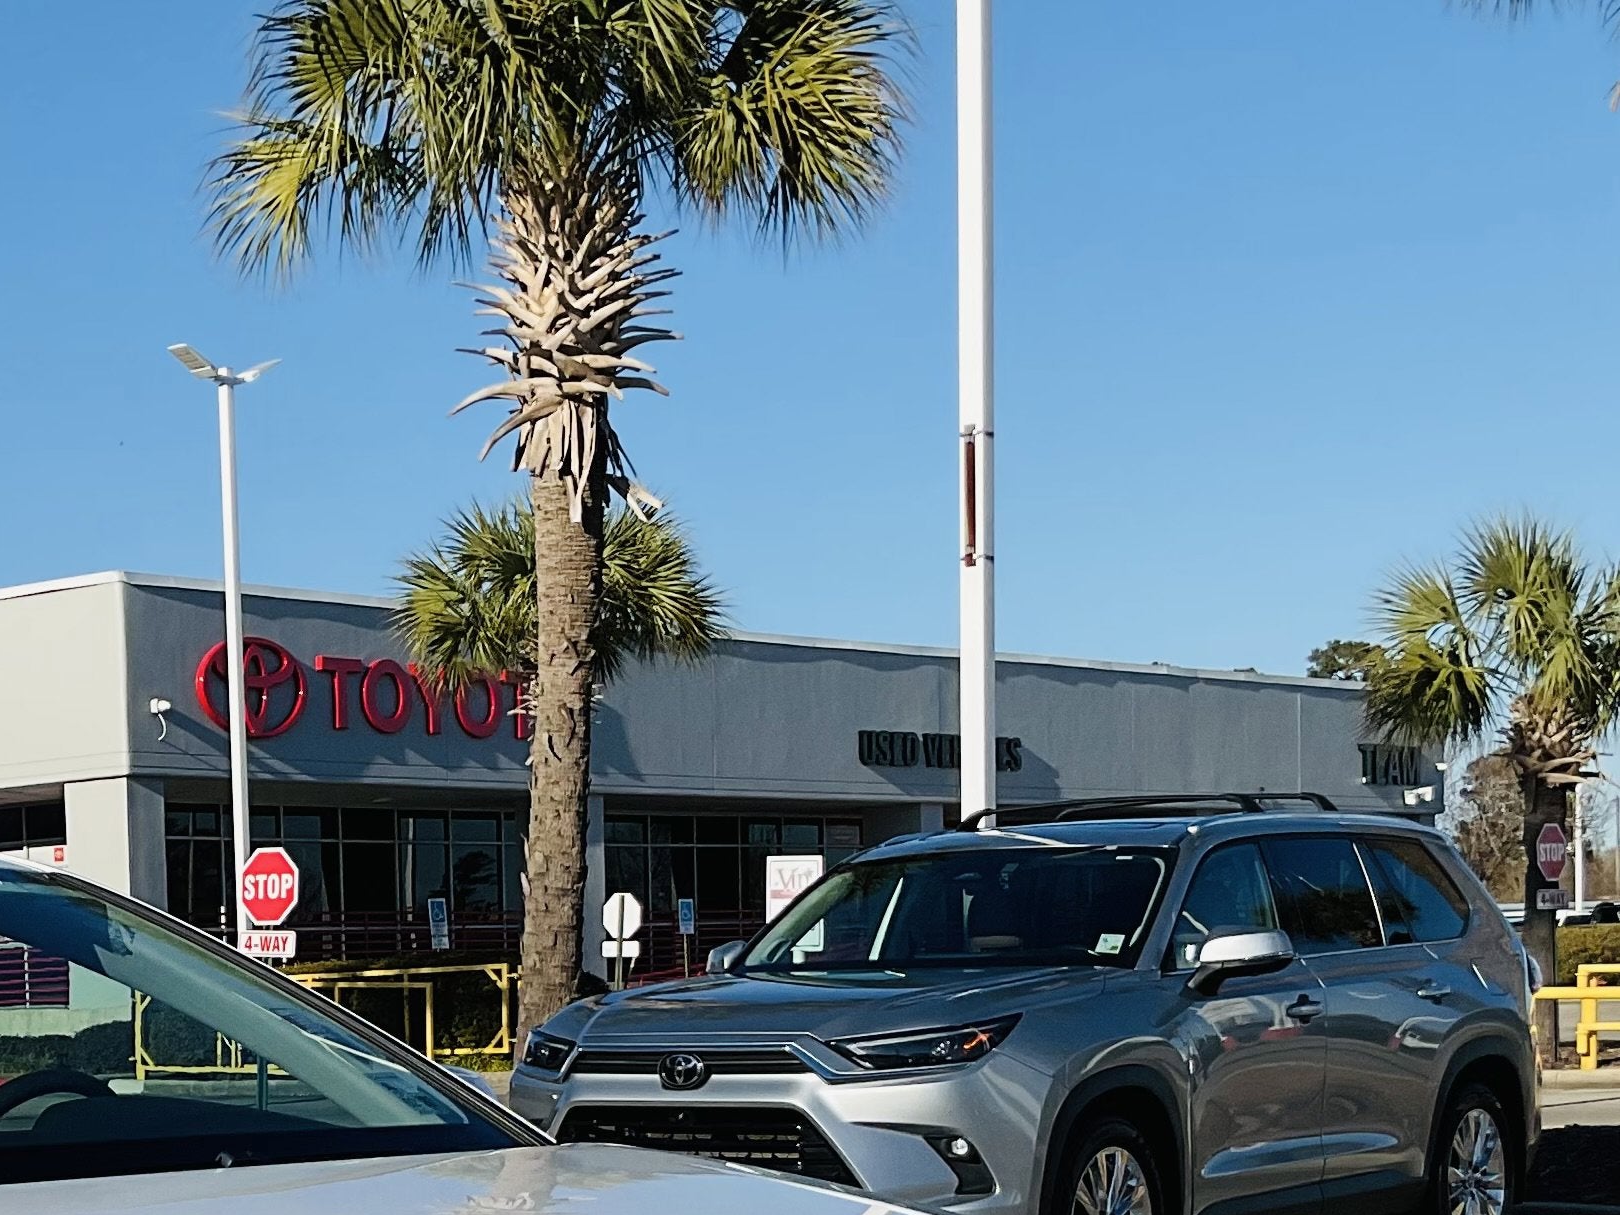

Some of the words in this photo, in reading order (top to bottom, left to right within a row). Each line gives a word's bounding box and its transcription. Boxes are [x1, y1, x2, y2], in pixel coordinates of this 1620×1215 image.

[314, 654, 536, 740] TOYOT
[858, 730, 921, 767] USED
[922, 733, 1023, 772] VEES
[1540, 843, 1565, 862] STOP
[243, 873, 294, 901] STOP
[244, 935, 289, 952] 4-WAY
